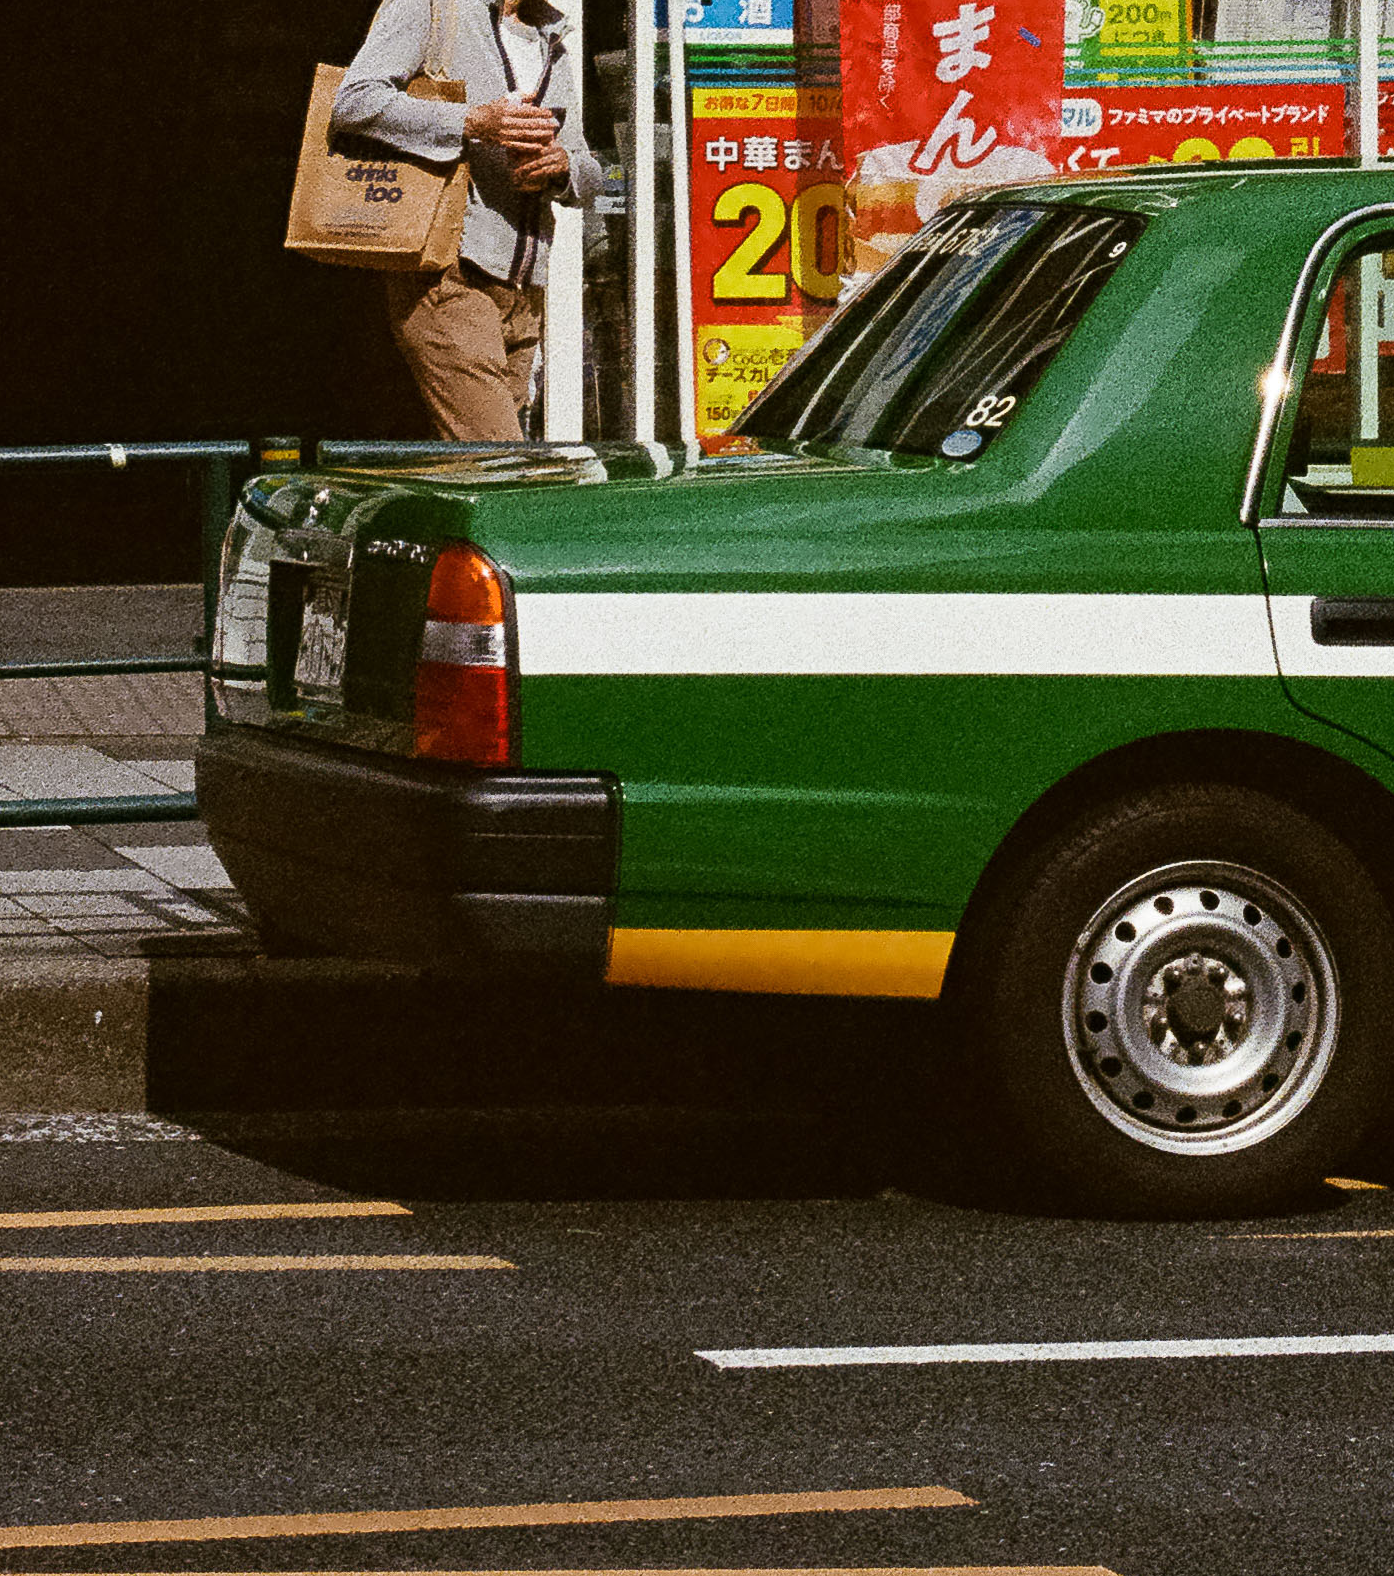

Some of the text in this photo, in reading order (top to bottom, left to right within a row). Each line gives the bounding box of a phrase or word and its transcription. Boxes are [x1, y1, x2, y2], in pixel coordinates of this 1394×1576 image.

[705, 93, 796, 113] お得な7日間
[1108, 104, 1331, 127] ファミマのプライベートブランド
[705, 135, 845, 173] 中華まん
[364, 183, 404, 204] too
[965, 395, 1018, 428] 82
